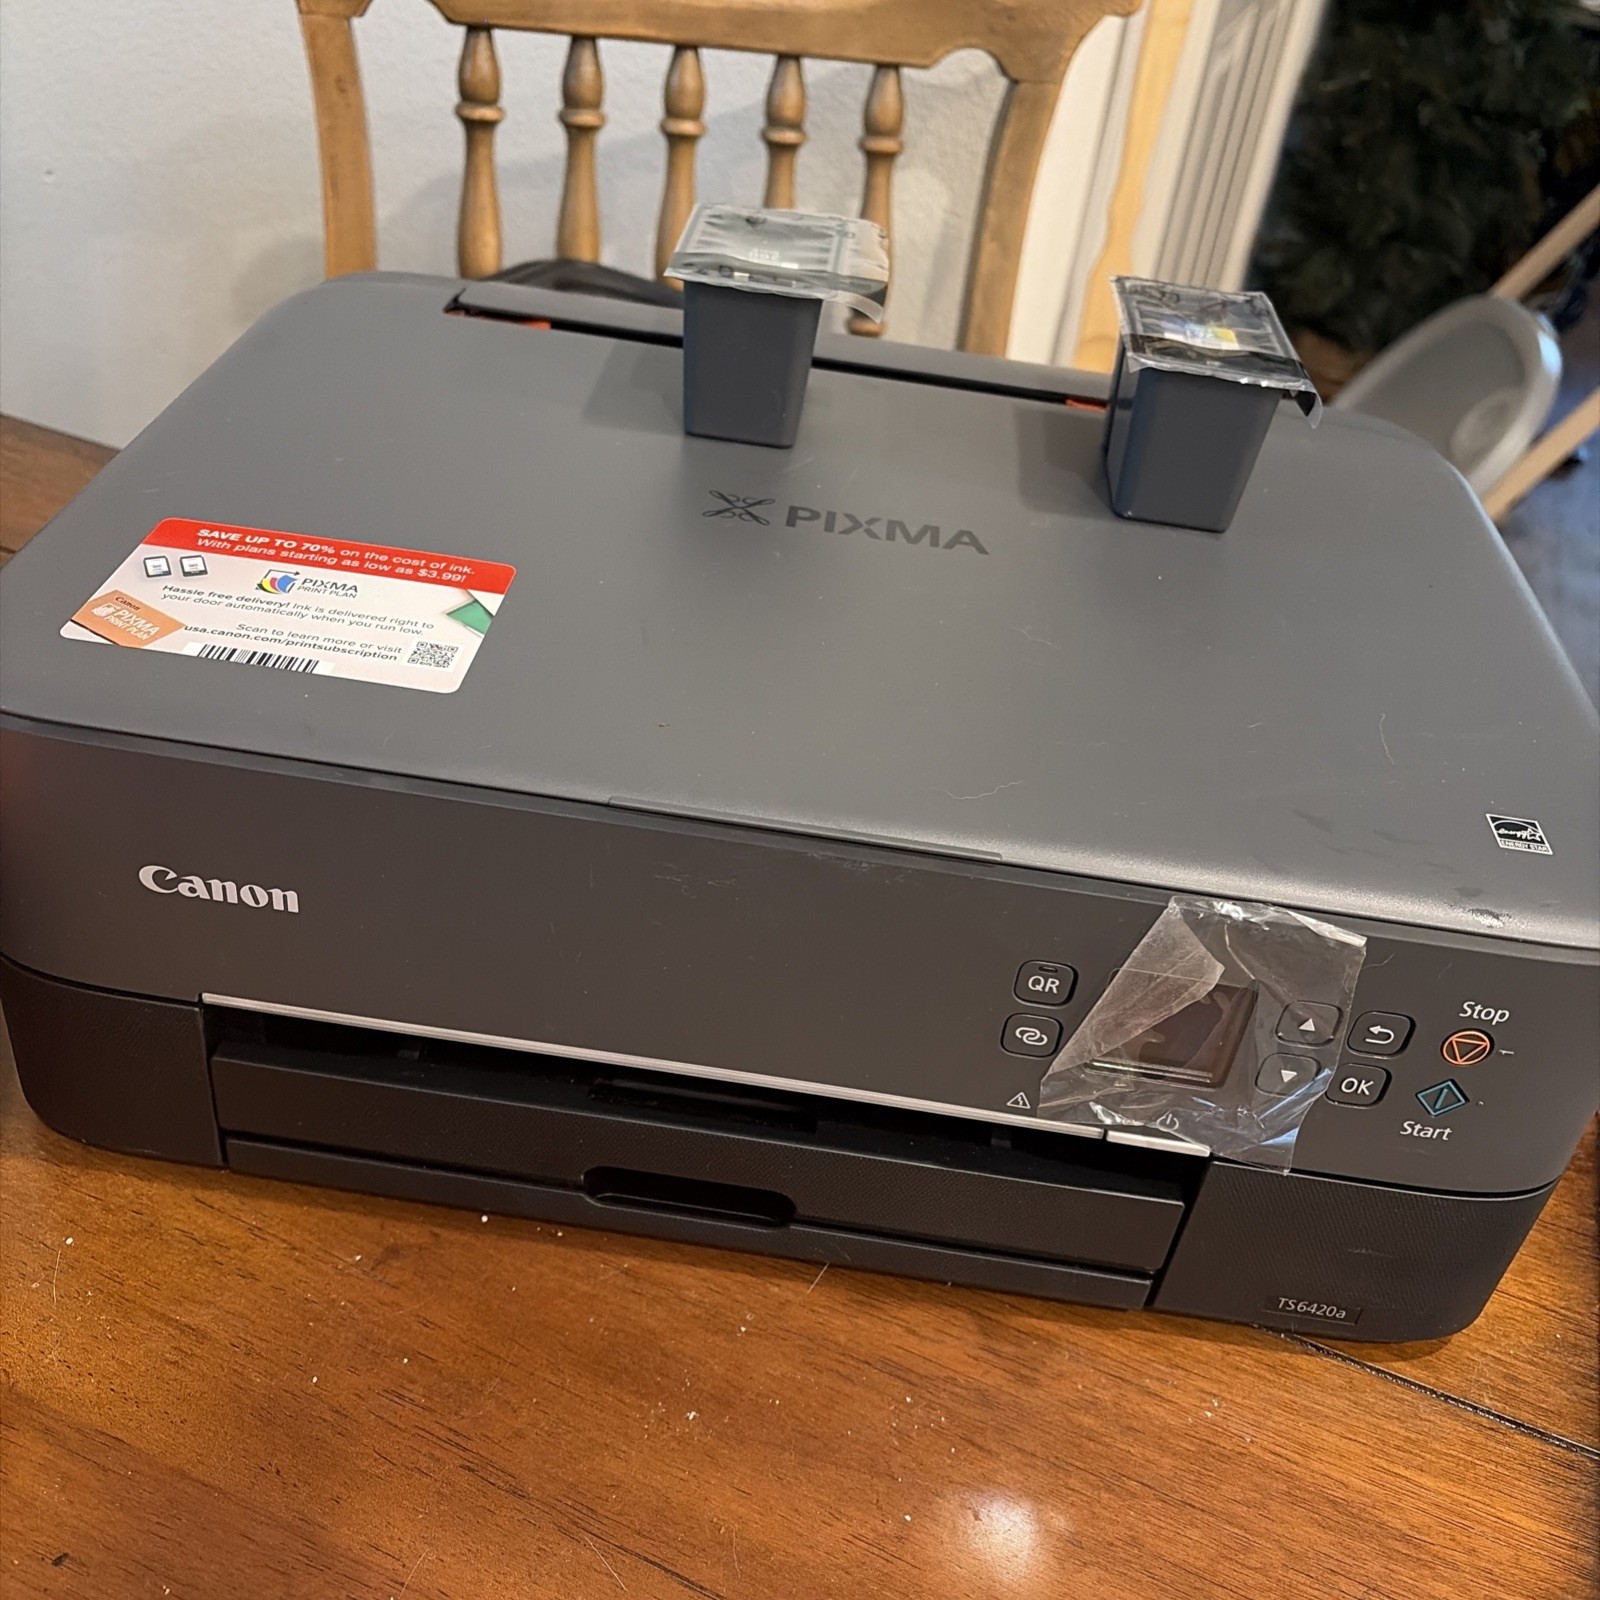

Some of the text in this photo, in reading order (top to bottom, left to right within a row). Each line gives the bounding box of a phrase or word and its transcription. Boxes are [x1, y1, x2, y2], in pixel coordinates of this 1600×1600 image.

[785, 505, 990, 556] PIXMA
[197, 529, 475, 575] SAVE UP TO 70% on the cost of ink.
[197, 538, 467, 582] With plans starting as low as $3.99!
[297, 586, 358, 599] PRINT PLAN
[301, 578, 358, 593] PIXMA
[115, 596, 141, 611] Canon
[161, 593, 191, 601] your
[193, 597, 223, 606] door
[225, 601, 308, 619] automatically
[311, 613, 345, 624] when
[347, 620, 372, 628] you
[399, 626, 424, 635] low.
[162, 585, 204, 596] Hassle
[207, 591, 233, 600] free
[235, 595, 290, 608] delivery!
[292, 603, 312, 611] Ink
[328, 609, 387, 622] delivered
[389, 618, 419, 628] right
[104, 615, 151, 641] PRINT PLAN
[114, 609, 160, 636] PIXMA
[184, 625, 397, 661] usa.canon.com/printsubscription
[236, 623, 268, 634] Scan
[271, 628, 284, 636] to
[287, 631, 320, 641] learn
[323, 637, 356, 646] more
[377, 645, 402, 654] visit
[1529, 844, 1550, 853] STAR
[138, 865, 299, 913] Canon
[1028, 975, 1060, 994] QR
[1459, 1001, 1510, 1025] Stop
[1341, 1077, 1374, 1096] OK
[1400, 1121, 1452, 1141] Start
[1279, 1297, 1346, 1319] TS6420a
